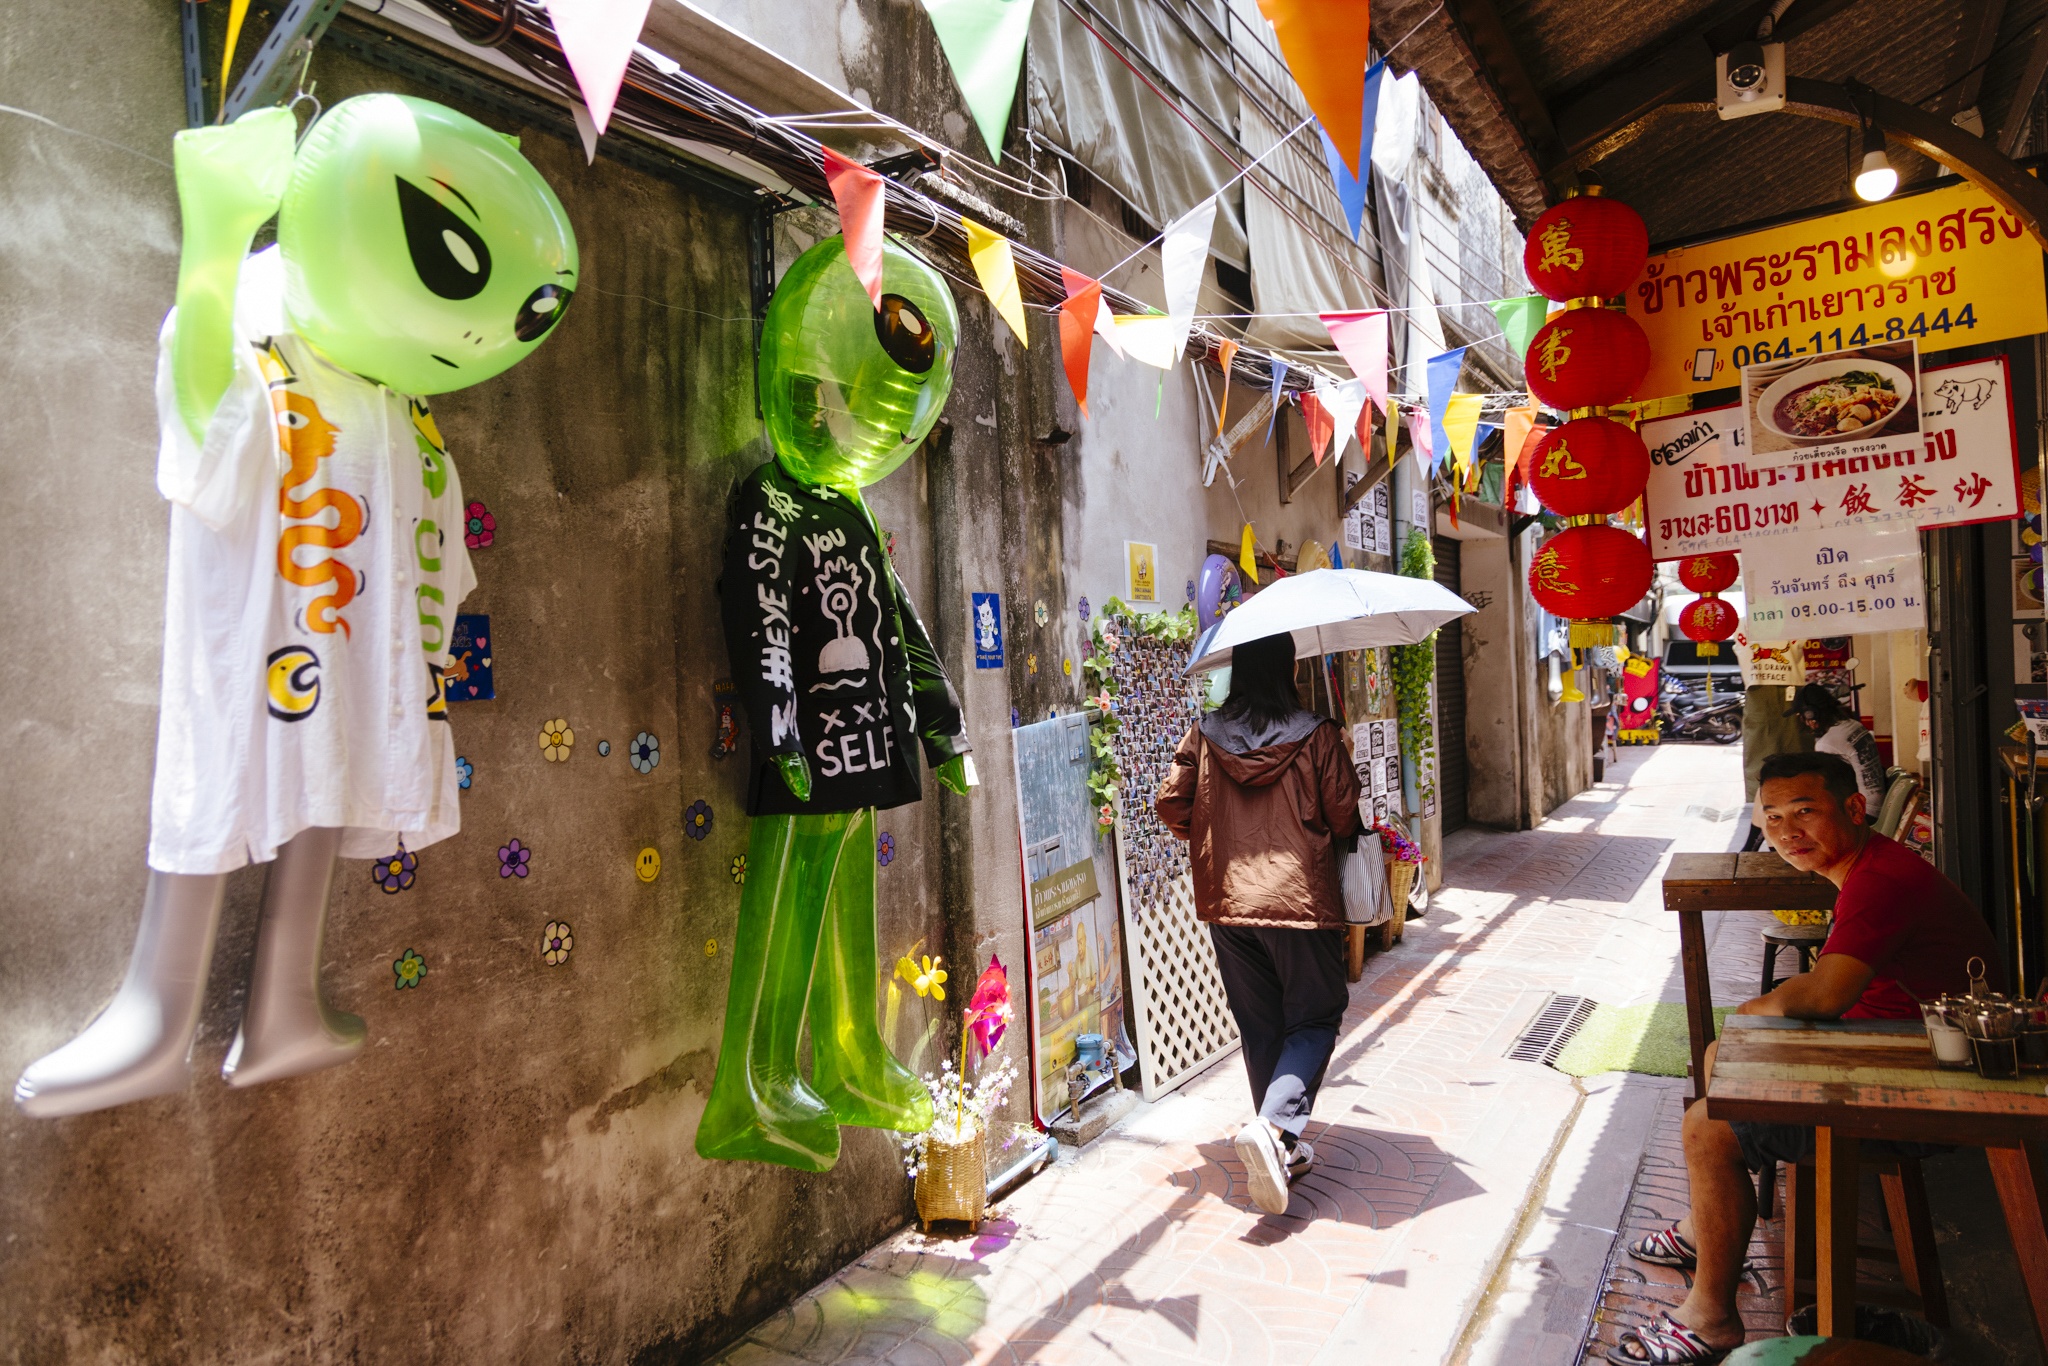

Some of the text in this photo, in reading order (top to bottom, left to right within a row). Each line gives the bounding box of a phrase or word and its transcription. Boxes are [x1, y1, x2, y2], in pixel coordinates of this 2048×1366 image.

[1538, 217, 1584, 273] 萬
[1638, 205, 2023, 315] ข้าวพระรามลงสรง
[1701, 266, 1957, 342] เจ้าเก่าเยาวราช
[1732, 302, 1978, 370] 064-114-8444
[802, 527, 847, 568] YOU
[1816, 547, 1849, 566] เปิด
[1771, 568, 1895, 595] วันจันทร์ ถึง ศุกร์
[1753, 596, 1921, 622] เวลา 09.00-15.00 น.
[1765, 663, 1793, 672] DRAWN
[816, 725, 895, 777] SELF
